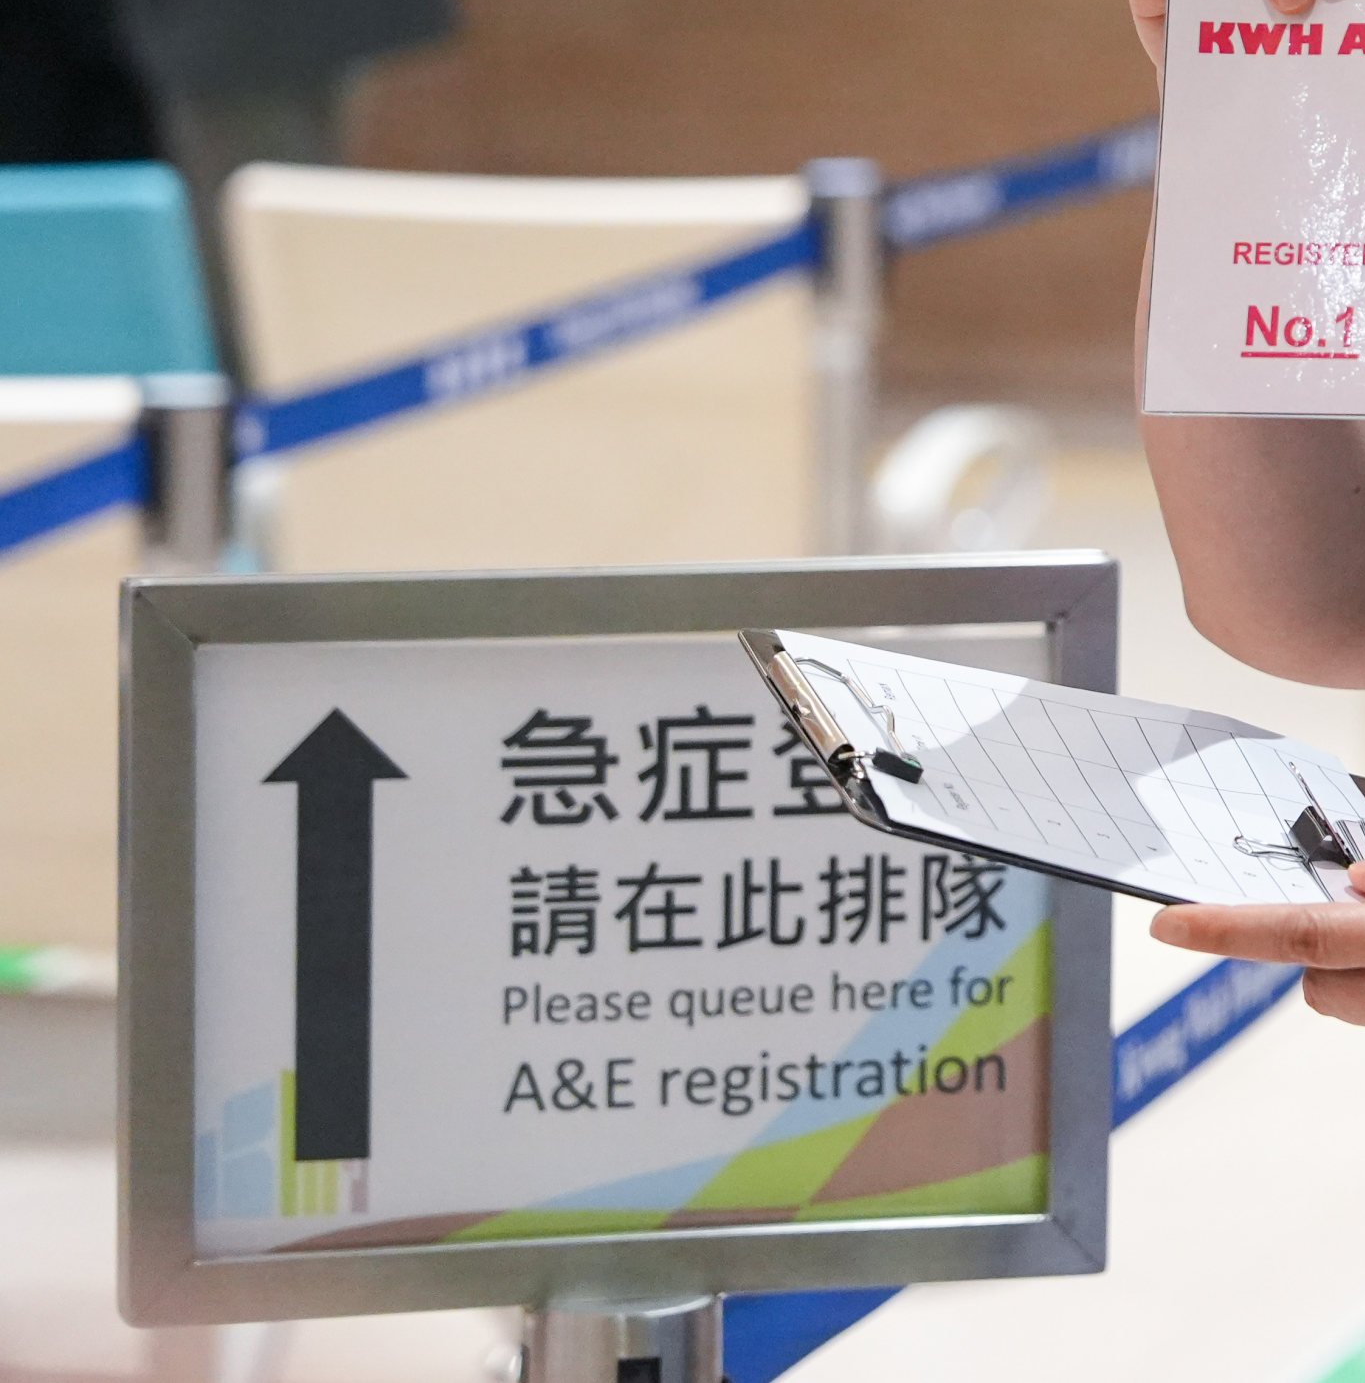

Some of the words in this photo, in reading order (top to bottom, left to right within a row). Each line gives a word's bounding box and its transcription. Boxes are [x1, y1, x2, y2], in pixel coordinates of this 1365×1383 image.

[1198, 21, 1324, 56] KWH
[510, 854, 1007, 957] 請在此排隊
[502, 983, 651, 1025] Please
[669, 983, 815, 1028] queue
[832, 970, 932, 1011] here
[950, 965, 1013, 1008] for
[504, 1056, 637, 1114] A&E
[660, 1044, 1006, 1117] registration
